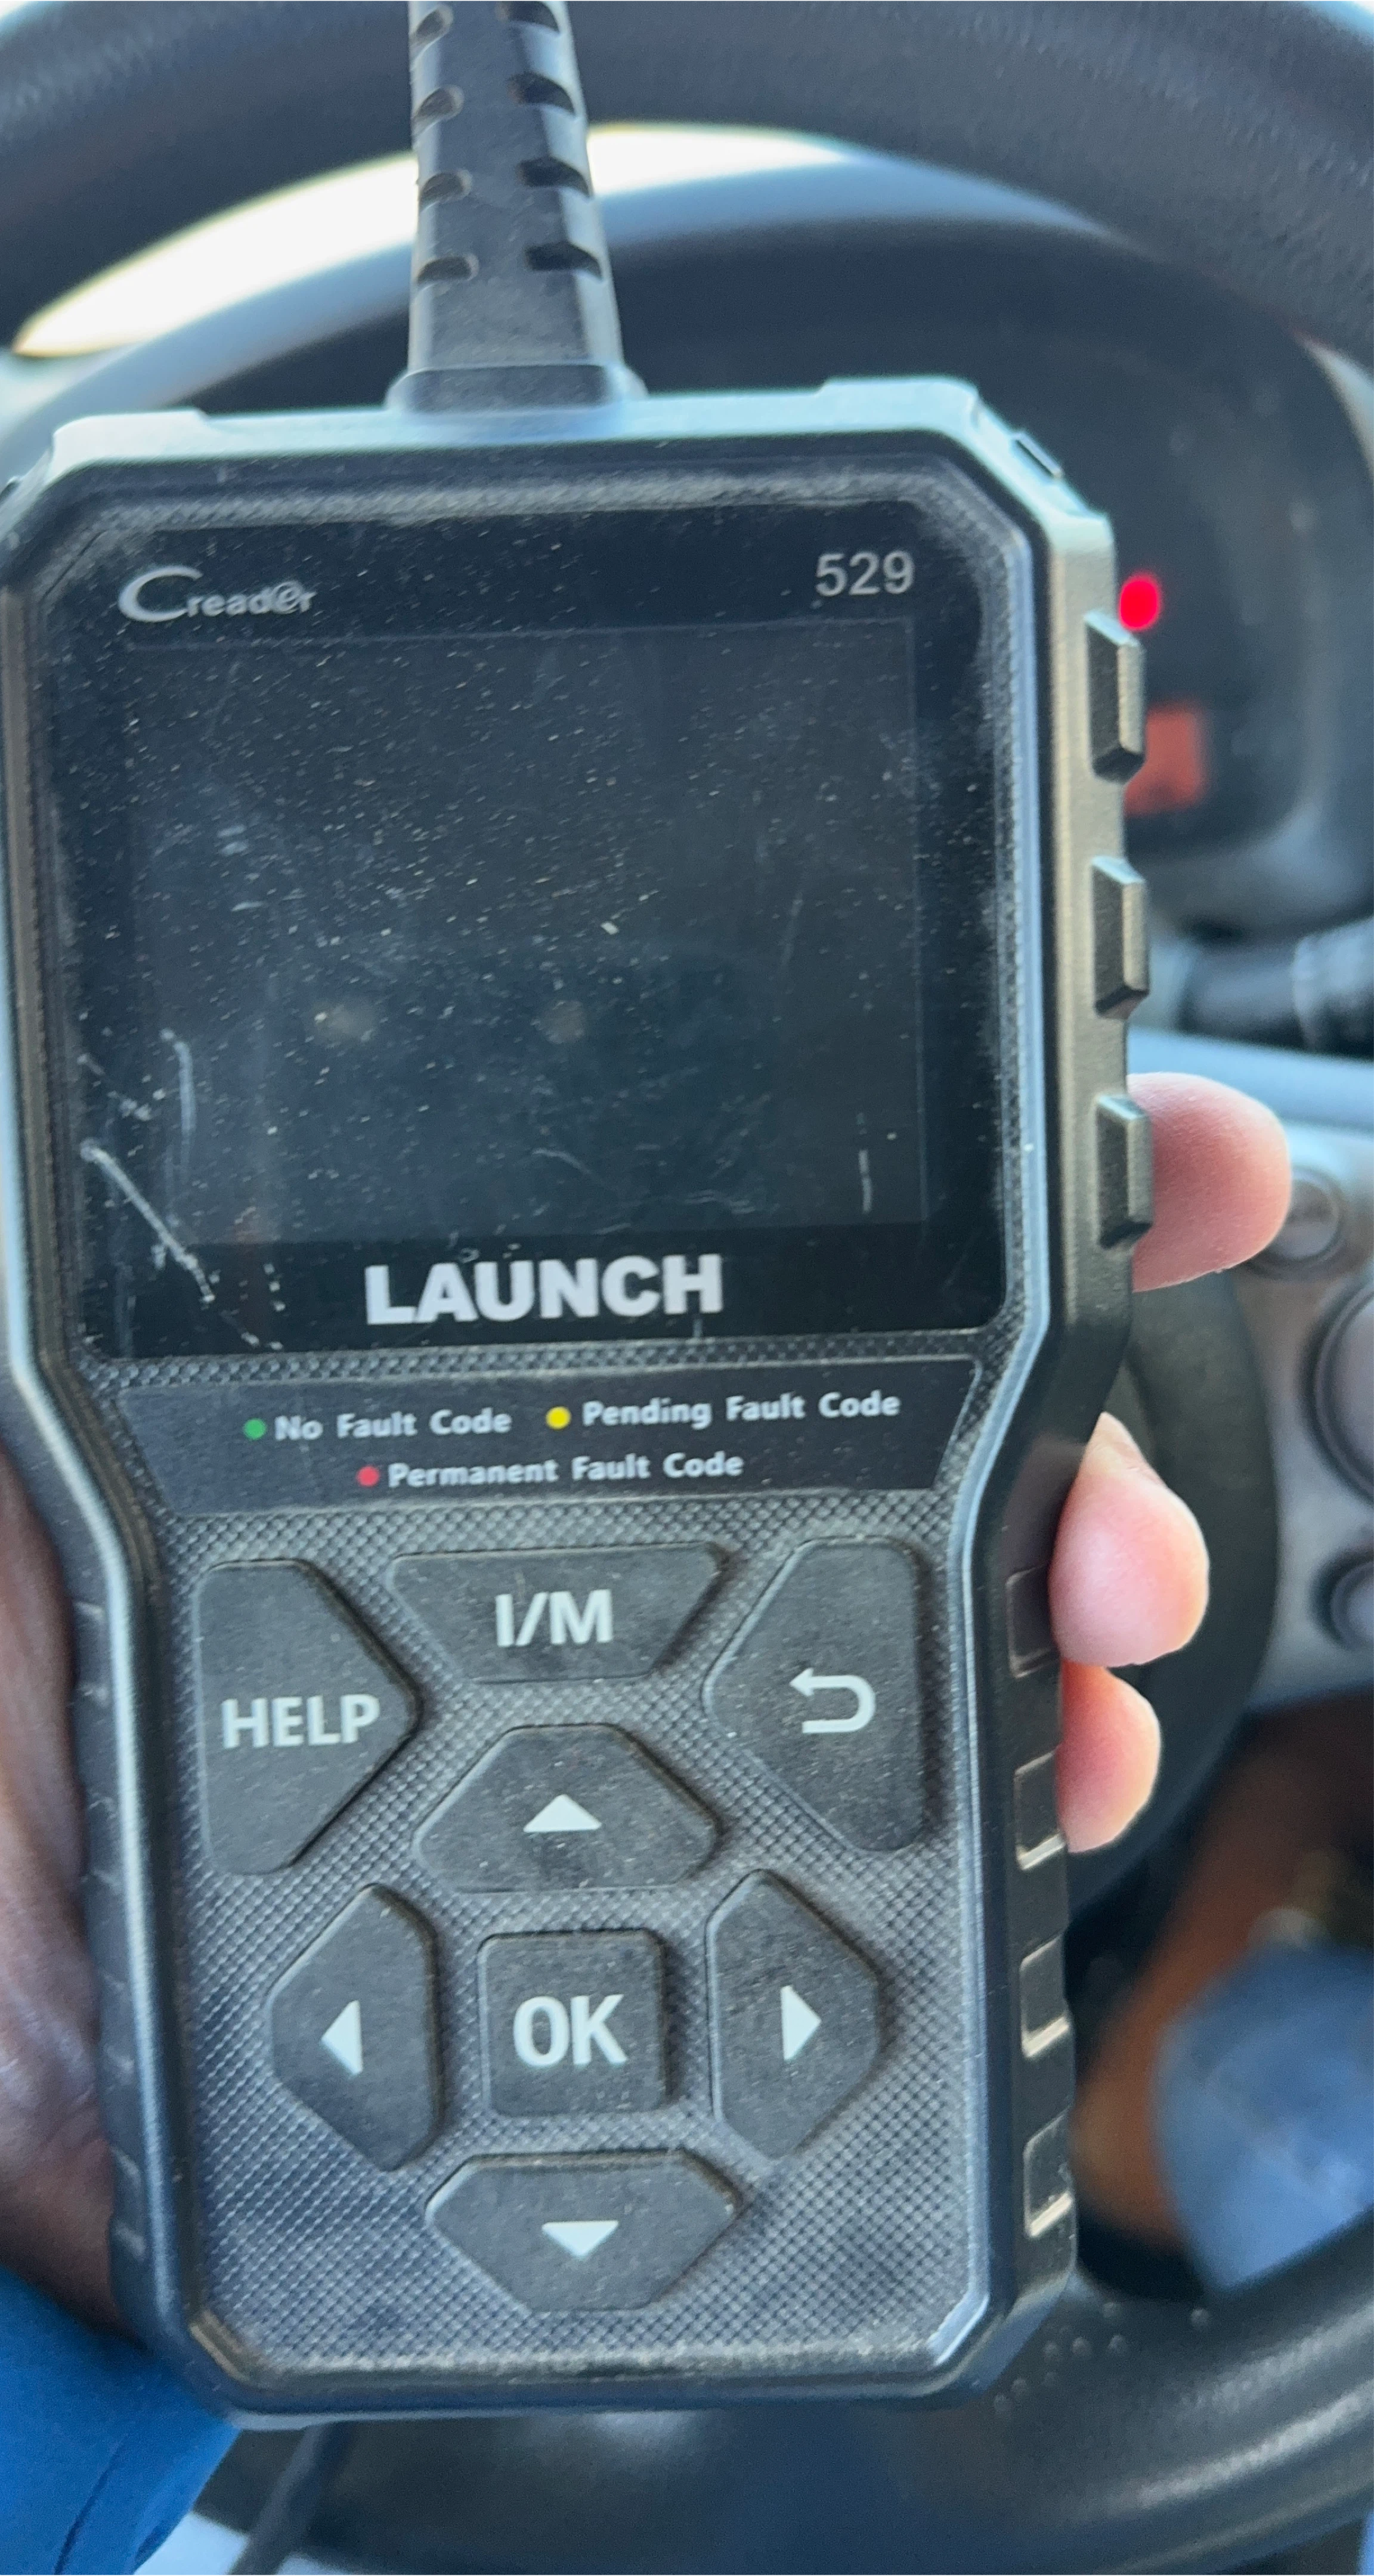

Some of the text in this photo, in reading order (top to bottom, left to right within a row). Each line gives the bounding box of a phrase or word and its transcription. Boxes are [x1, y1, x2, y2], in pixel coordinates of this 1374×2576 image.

[816, 551, 914, 597] 529
[364, 1254, 724, 1325] LAUNCH
[274, 1408, 512, 1441] No Fault Code
[582, 1389, 901, 1431] Pending Fault Code
[388, 1450, 744, 1489] Permanent Fault Code
[495, 1589, 613, 1648] I/M
[221, 1693, 380, 1748] HELP
[513, 1993, 628, 2067] OK
